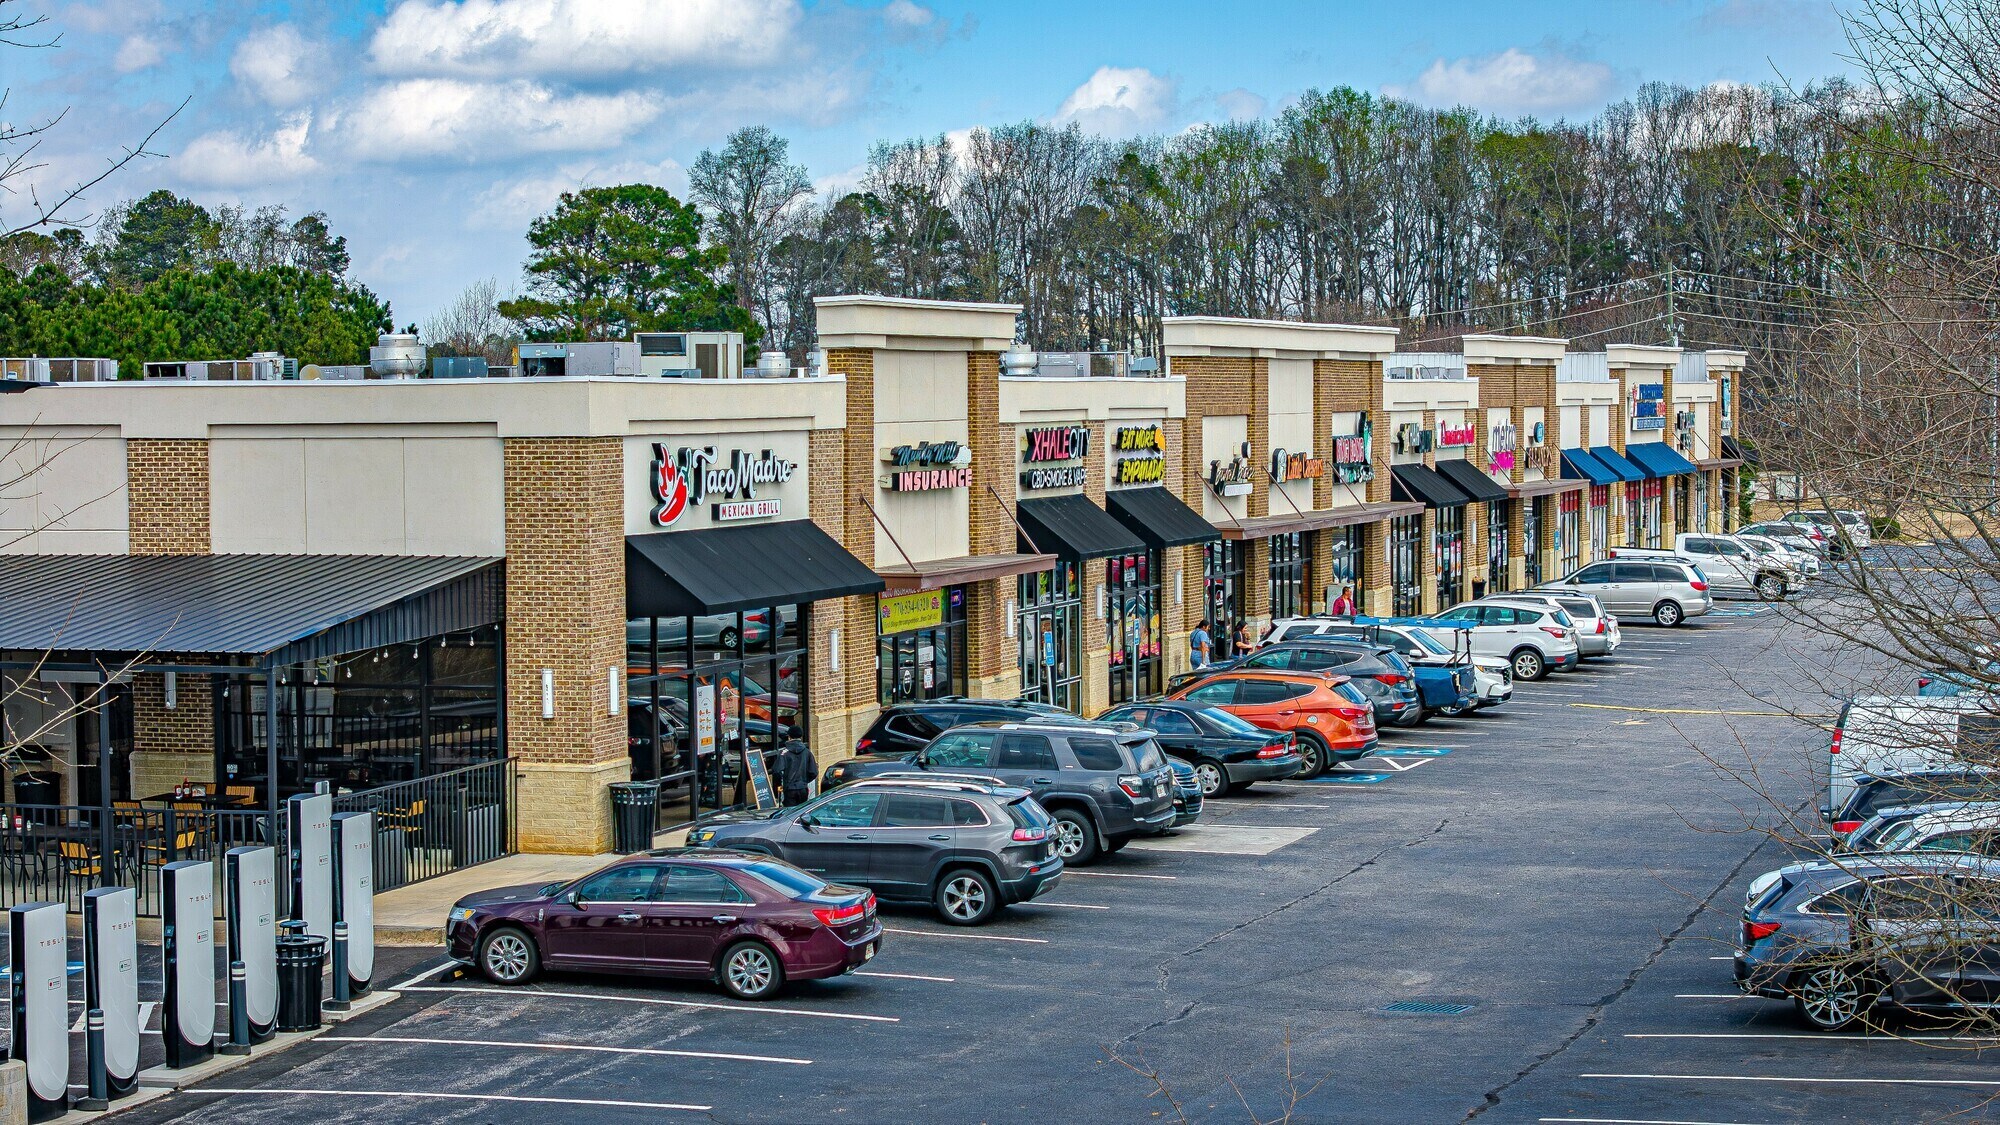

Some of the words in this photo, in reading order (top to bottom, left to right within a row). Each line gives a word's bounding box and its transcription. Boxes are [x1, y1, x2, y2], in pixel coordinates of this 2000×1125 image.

[1122, 430, 1135, 449] EAT
[1135, 429, 1154, 449] MORE
[1492, 419, 1516, 451] metro
[693, 446, 735, 505] Taco
[733, 449, 791, 499] Madre
[900, 468, 972, 491] INSURANCE
[722, 504, 754, 517] MEXICAN
[758, 502, 778, 514] GRILL
